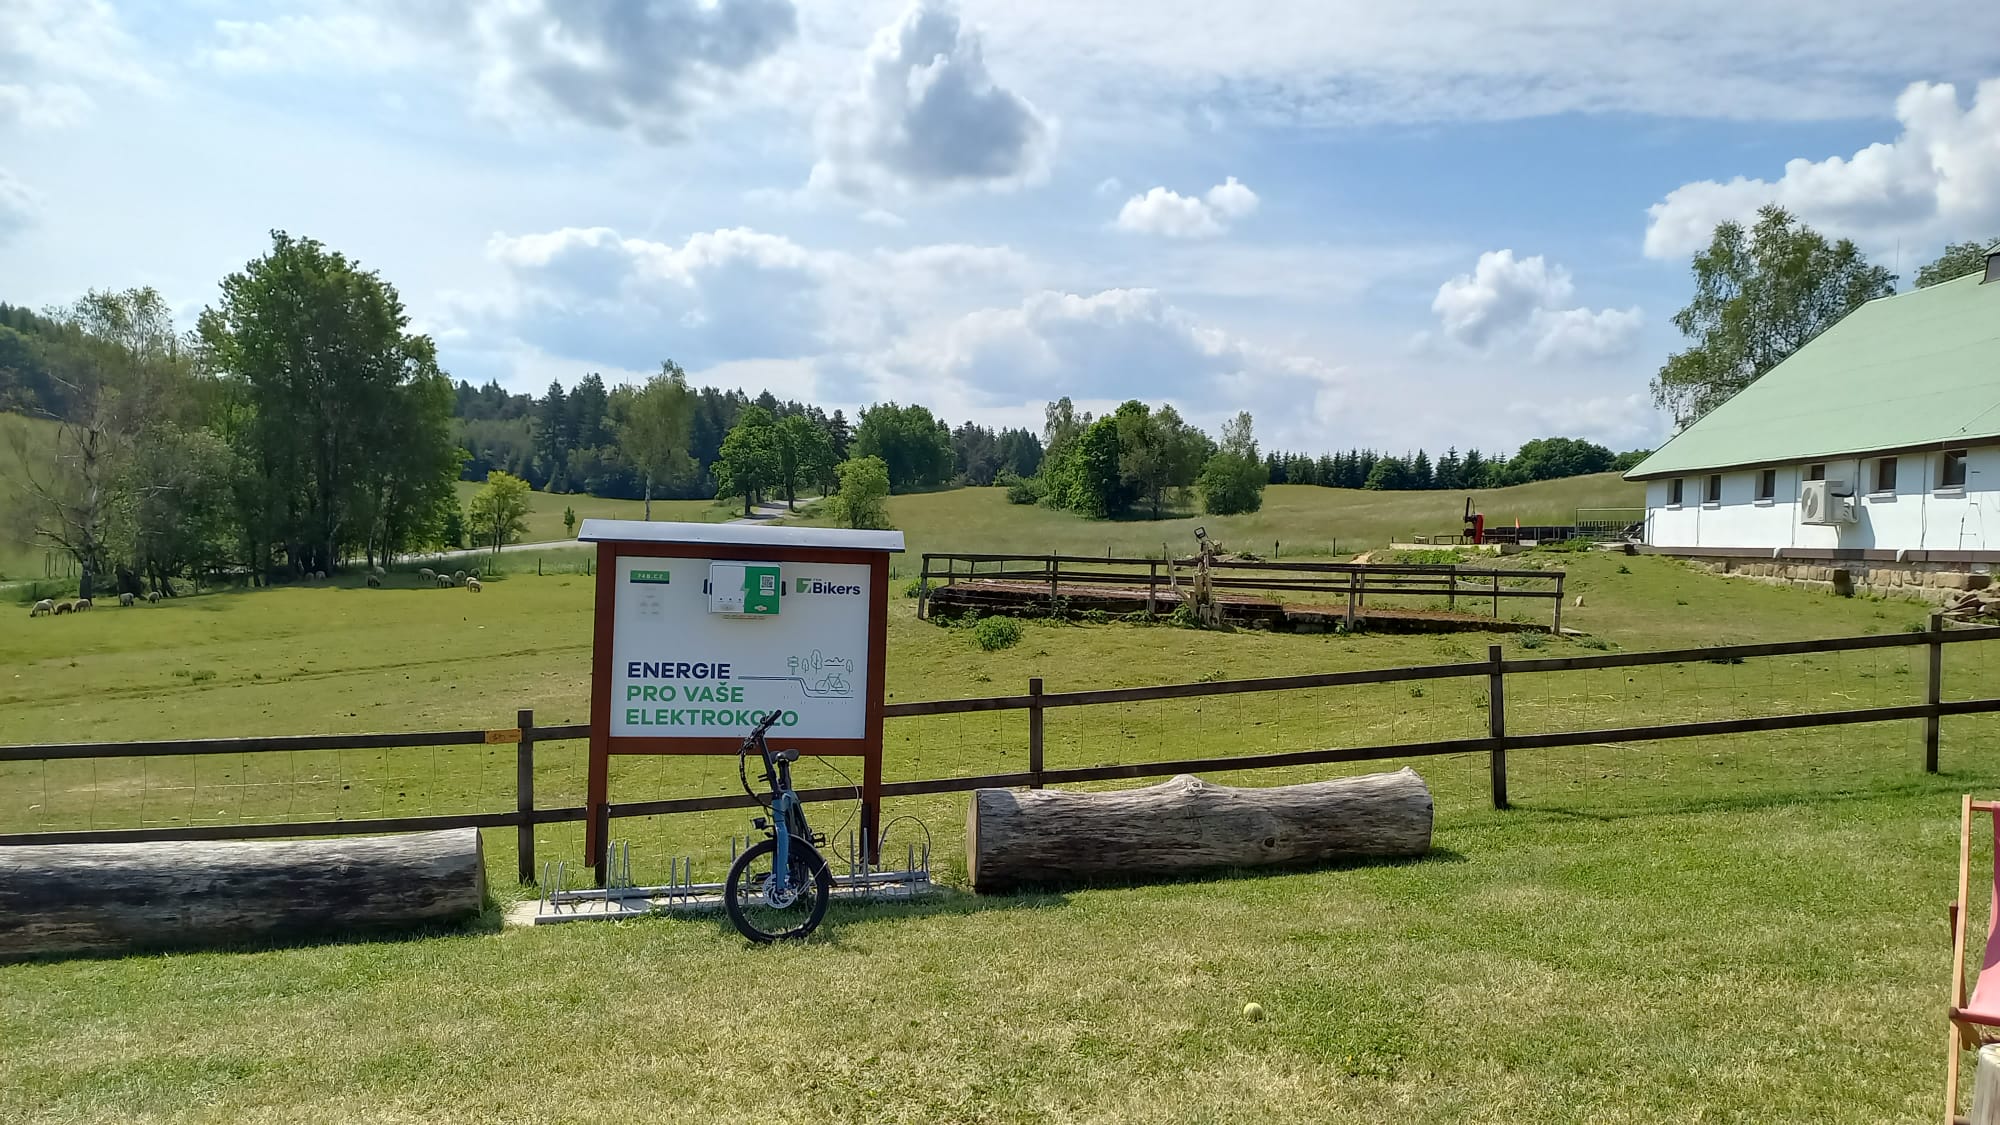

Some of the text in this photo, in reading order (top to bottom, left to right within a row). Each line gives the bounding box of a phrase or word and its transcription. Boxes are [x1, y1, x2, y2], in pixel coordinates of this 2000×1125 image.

[812, 581, 861, 596] Bikers
[627, 662, 731, 679] ENERGIE
[626, 682, 744, 703] PRO VAŠE
